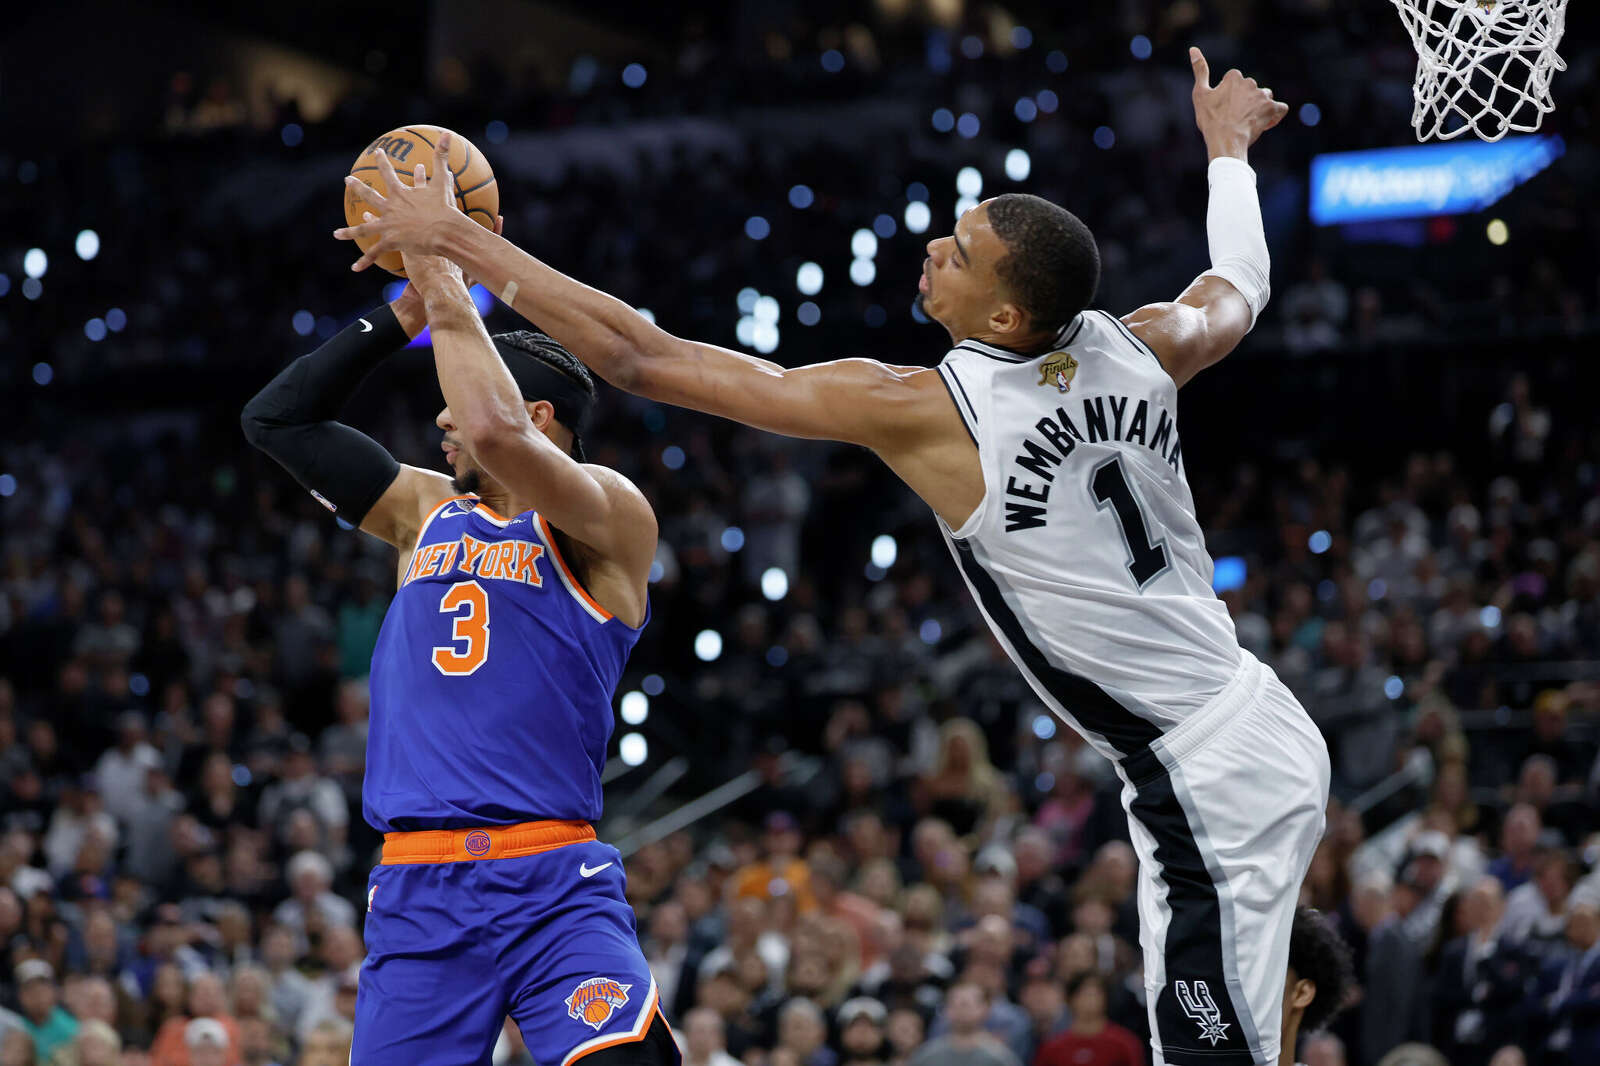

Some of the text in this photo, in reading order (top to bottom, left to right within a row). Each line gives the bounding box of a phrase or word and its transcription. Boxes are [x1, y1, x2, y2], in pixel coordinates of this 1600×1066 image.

[1038, 356, 1077, 385] Finals
[1005, 395, 1182, 533] WEMBANYAMA
[1087, 451, 1173, 592] 1
[403, 532, 545, 588] NEW YORK
[432, 580, 490, 676] 3
[570, 982, 627, 1015] KNICKS
